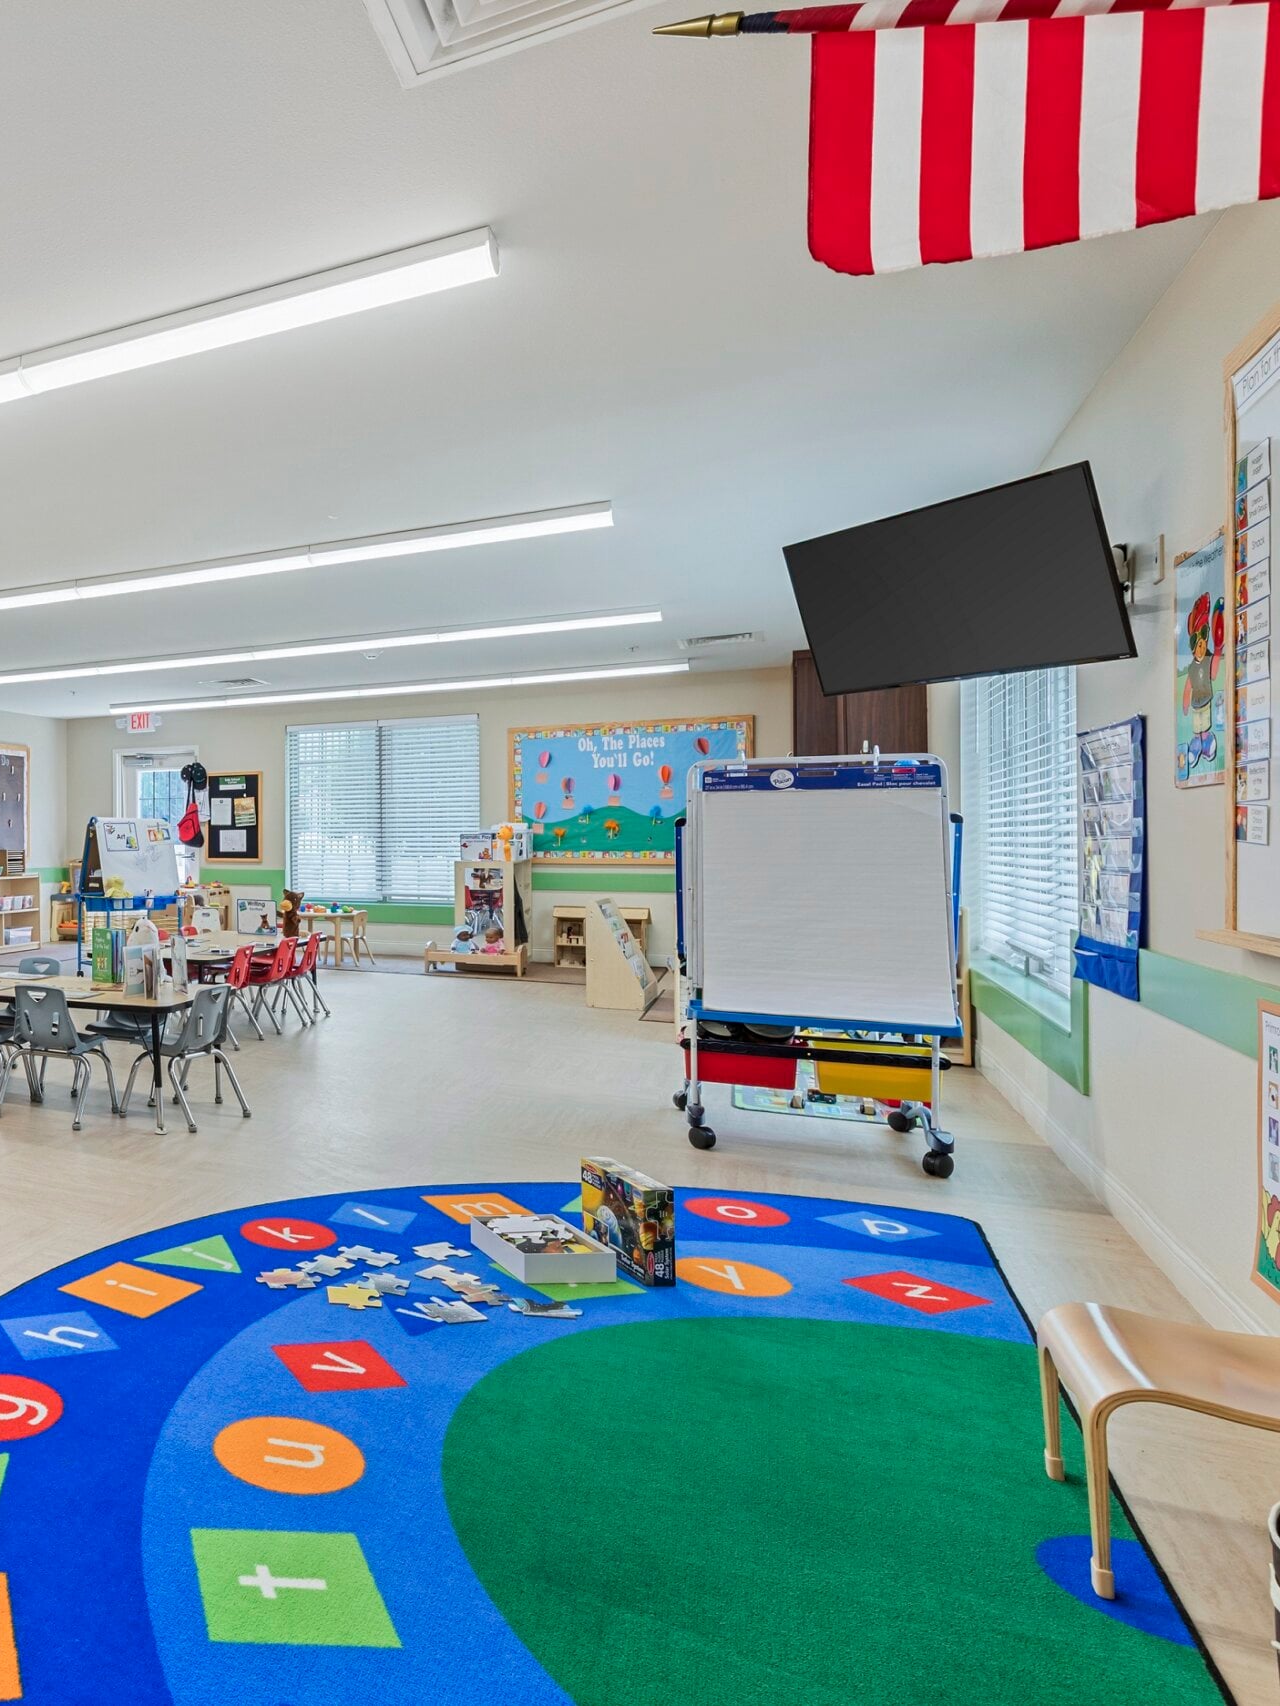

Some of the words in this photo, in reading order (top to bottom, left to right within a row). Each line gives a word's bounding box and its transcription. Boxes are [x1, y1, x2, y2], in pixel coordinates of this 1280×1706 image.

[131, 712, 149, 729] EXIT
[577, 737, 598, 753] Oh,
[602, 736, 624, 751] The
[628, 734, 665, 749] Places
[591, 752, 627, 768] You'll
[632, 751, 654, 766] Go!
[582, 1170, 593, 1184] 48
[450, 1201, 513, 1217] m
[732, 1205, 758, 1219] o
[257, 1225, 315, 1244] k
[862, 1218, 909, 1236] p
[178, 1245, 230, 1271] j
[654, 1263, 665, 1278] 48
[708, 1264, 743, 1291] y
[105, 1279, 159, 1297] i
[23, 1325, 100, 1350] h
[310, 1351, 367, 1376] v
[263, 1437, 326, 1469] u
[238, 1564, 328, 1599] t
